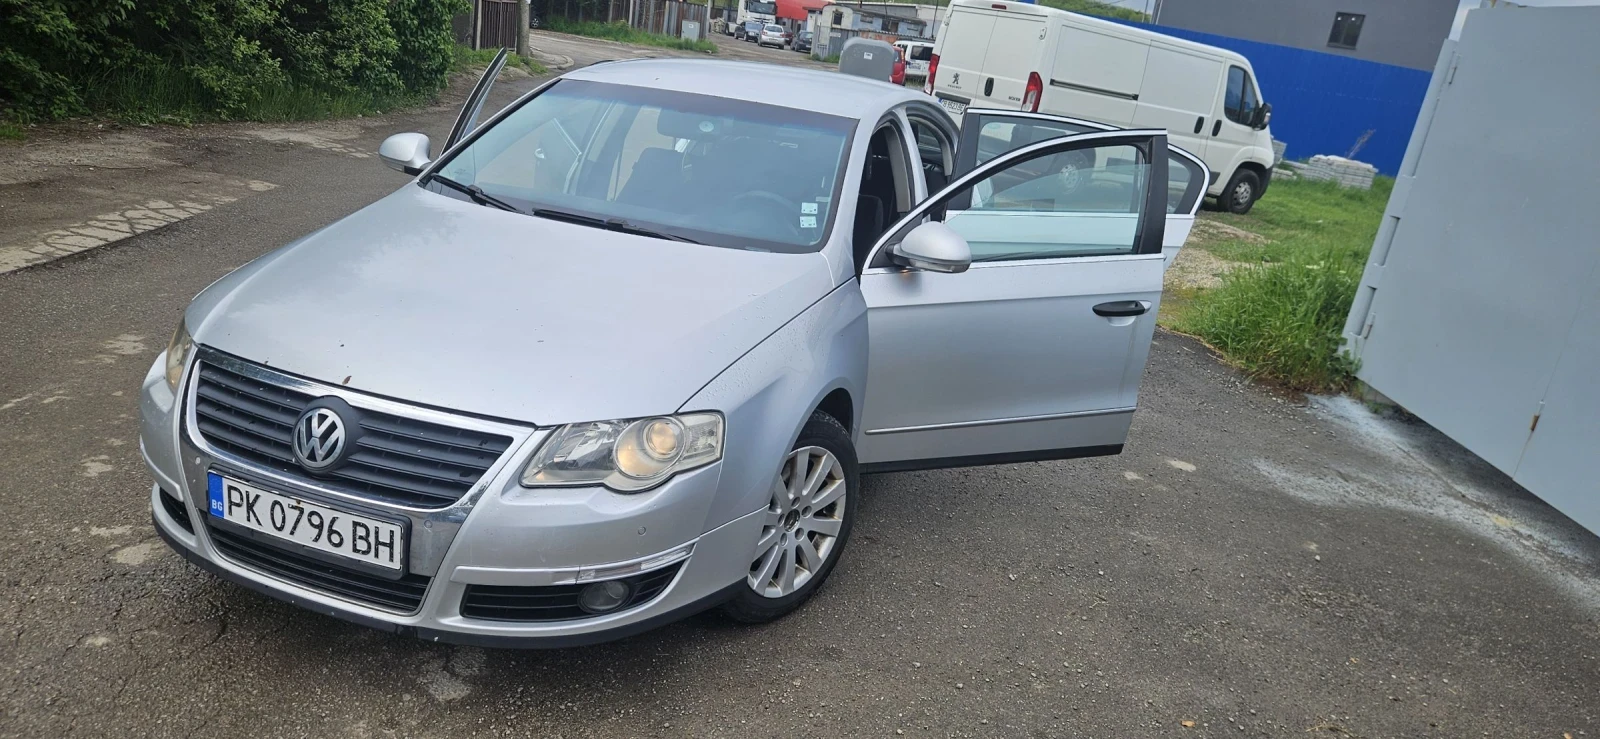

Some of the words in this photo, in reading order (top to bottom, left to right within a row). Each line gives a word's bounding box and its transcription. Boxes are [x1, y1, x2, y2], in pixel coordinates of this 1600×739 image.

[296, 408, 346, 468] VW
[211, 499, 223, 511] BG
[226, 484, 263, 526] PK
[270, 499, 344, 548] 0796
[351, 520, 395, 562] BH
